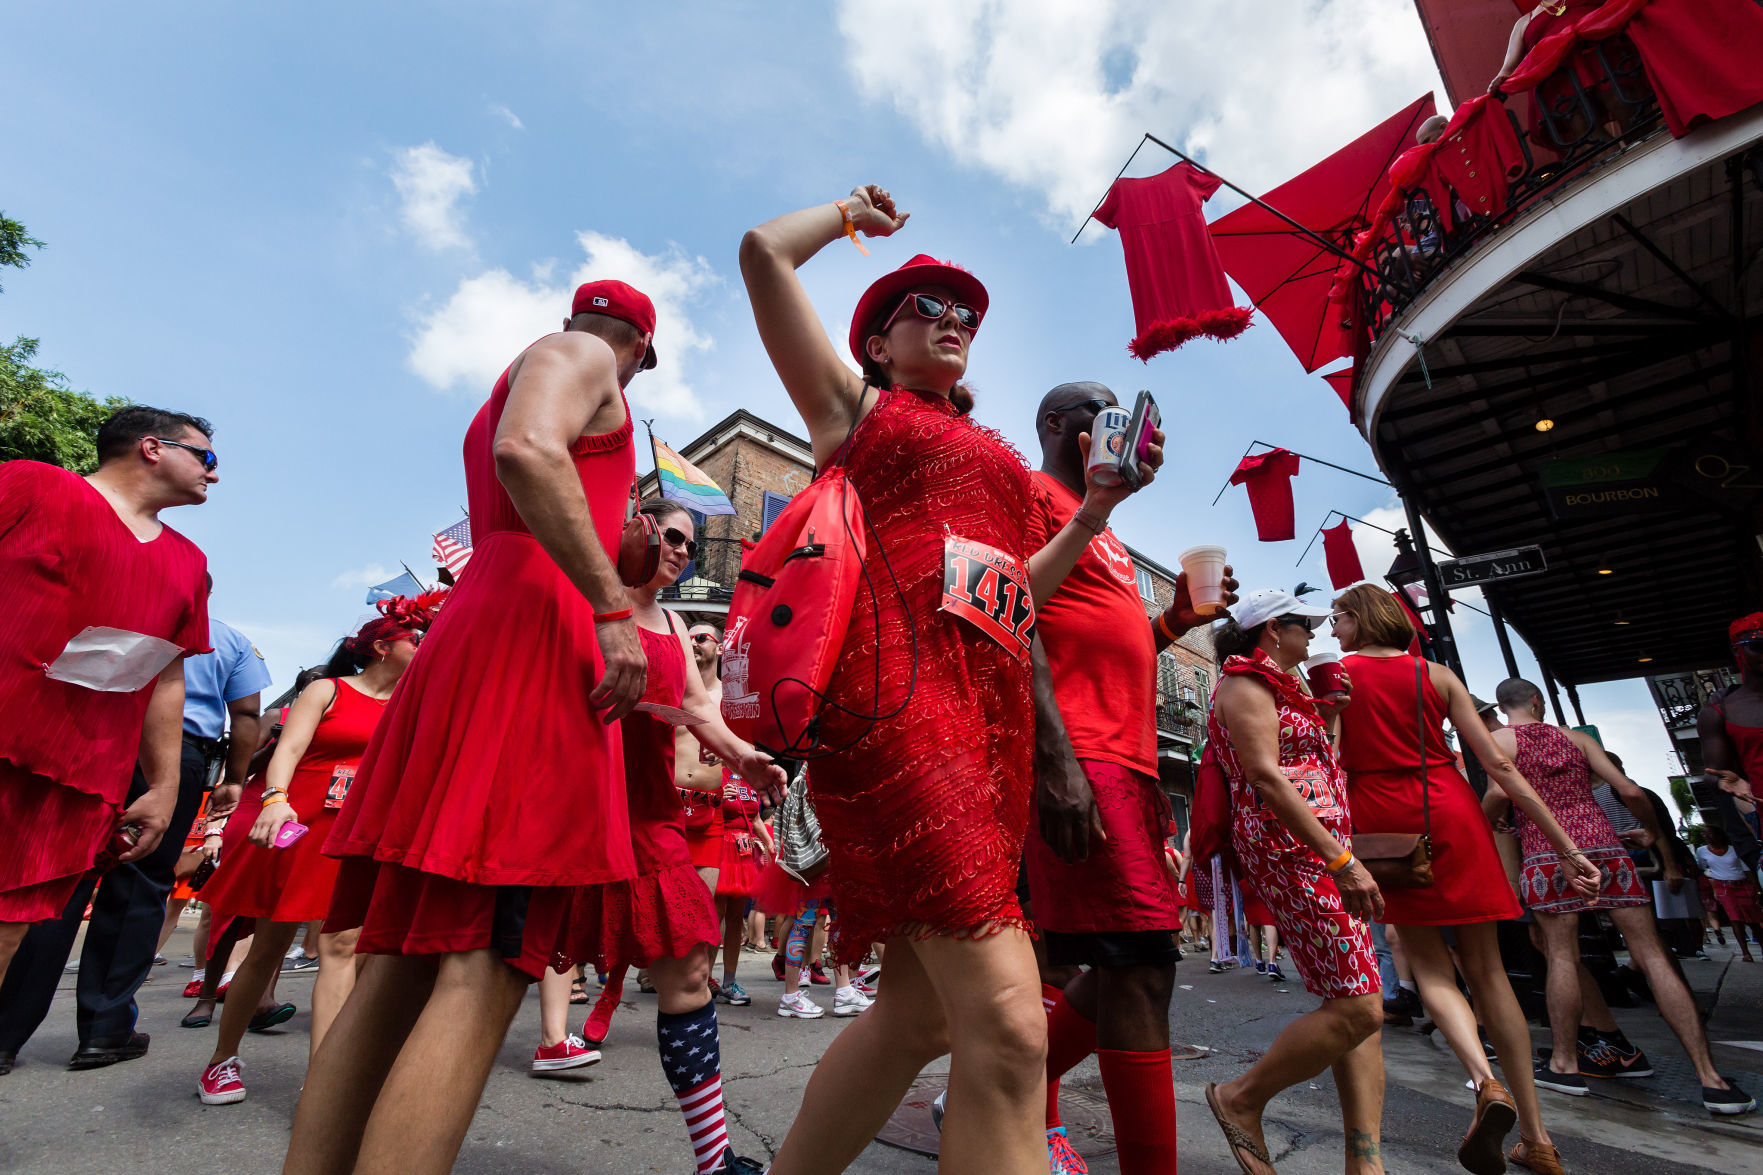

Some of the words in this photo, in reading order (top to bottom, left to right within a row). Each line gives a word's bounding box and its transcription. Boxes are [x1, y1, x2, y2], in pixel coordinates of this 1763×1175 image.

[1105, 412, 1129, 429] Lit
[1583, 466, 1620, 480] 800
[1565, 487, 1659, 506] BOURBON
[952, 541, 980, 557] RED
[985, 552, 1022, 581] DRESS
[1454, 565, 1480, 582] St.
[1489, 559, 1532, 577] Ann
[950, 556, 1035, 649] 1412
[329, 776, 353, 800] 4
[728, 786, 759, 803] SA
[1292, 779, 1334, 809] 20
